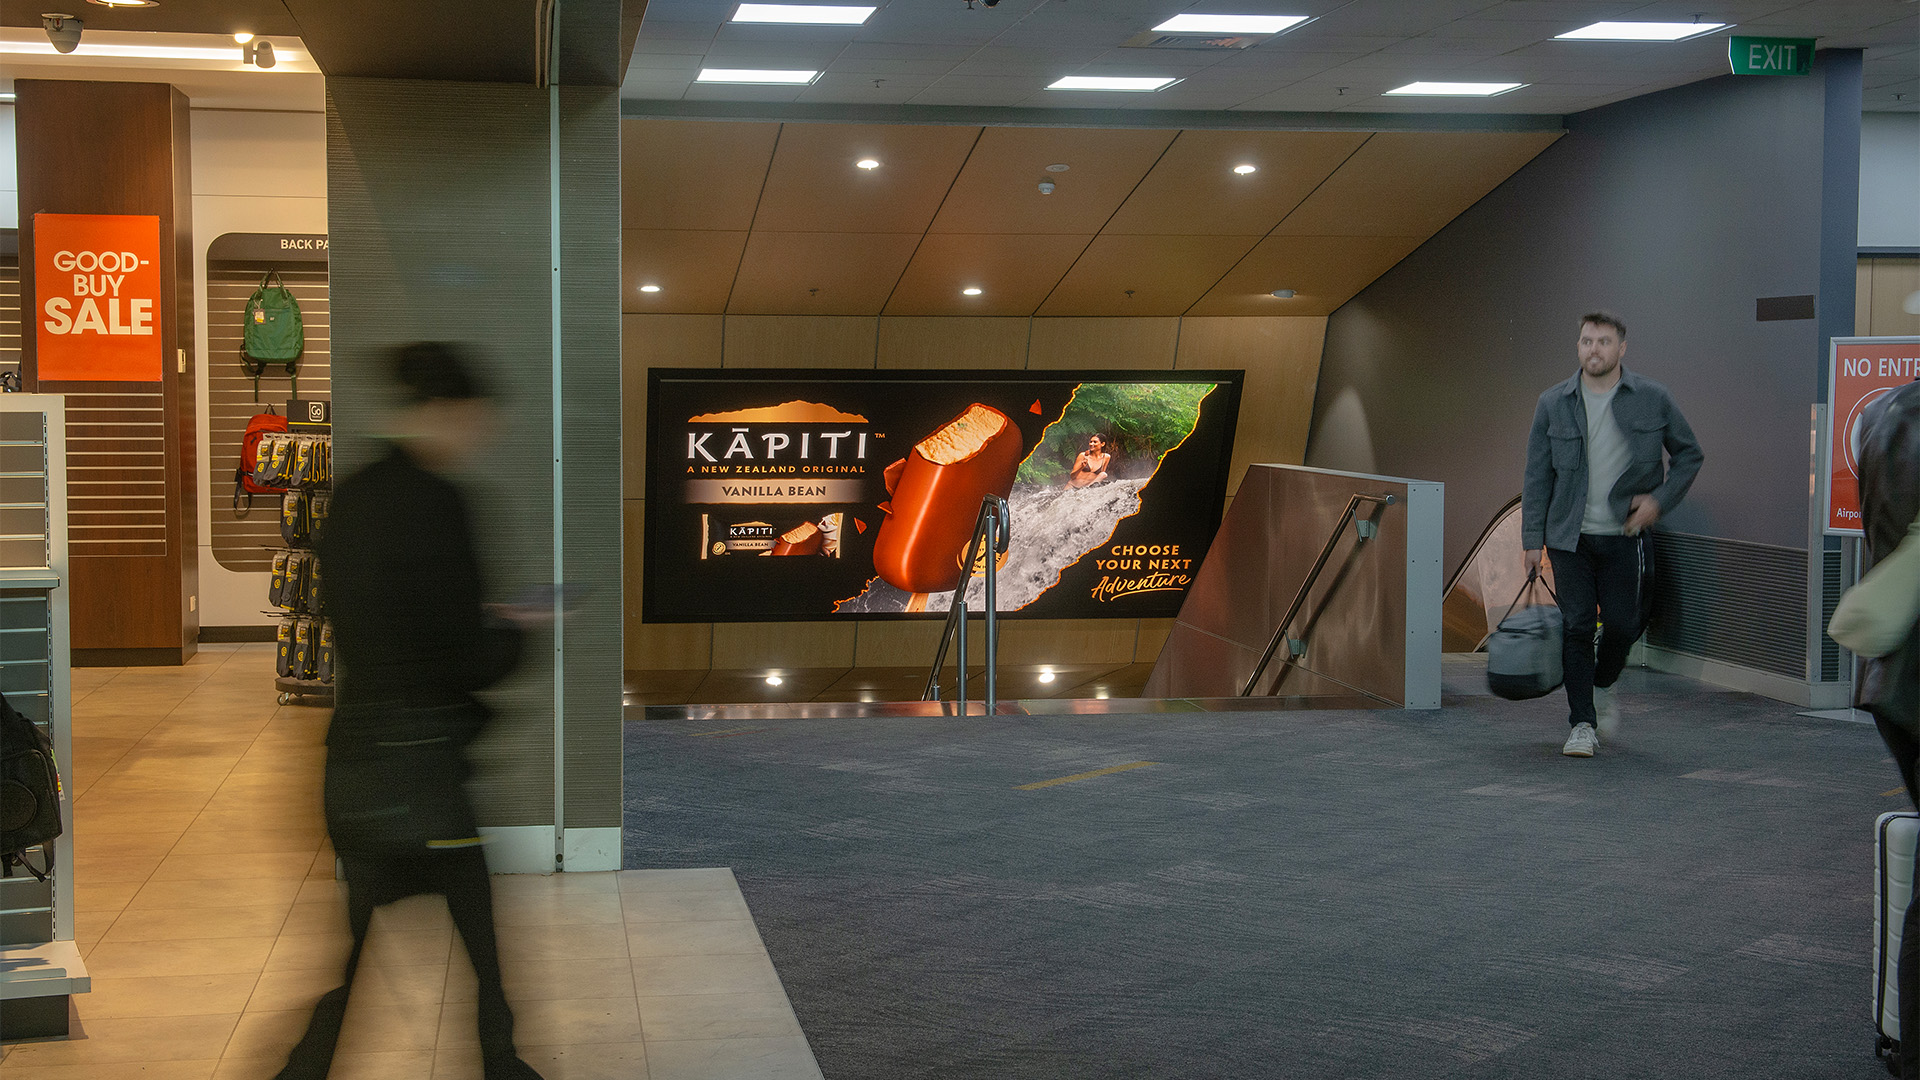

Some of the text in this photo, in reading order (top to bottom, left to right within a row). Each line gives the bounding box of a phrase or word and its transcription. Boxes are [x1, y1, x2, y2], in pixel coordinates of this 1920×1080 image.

[1748, 44, 1796, 70] EXIT
[280, 239, 313, 250] BACK
[53, 250, 150, 273] GOOD-
[73, 274, 125, 297] BUY
[44, 297, 153, 336] SALE
[1843, 358, 1872, 377] NO
[687, 427, 867, 463] KĀPITI
[686, 465, 865, 473] A NEW ZEALAND ORIGINAL
[722, 486, 827, 497] VANILLA BEAN
[1111, 545, 1180, 556] CHOOSE
[1095, 559, 1192, 570] YOUR NEXT
[1091, 571, 1191, 602] Adventure
